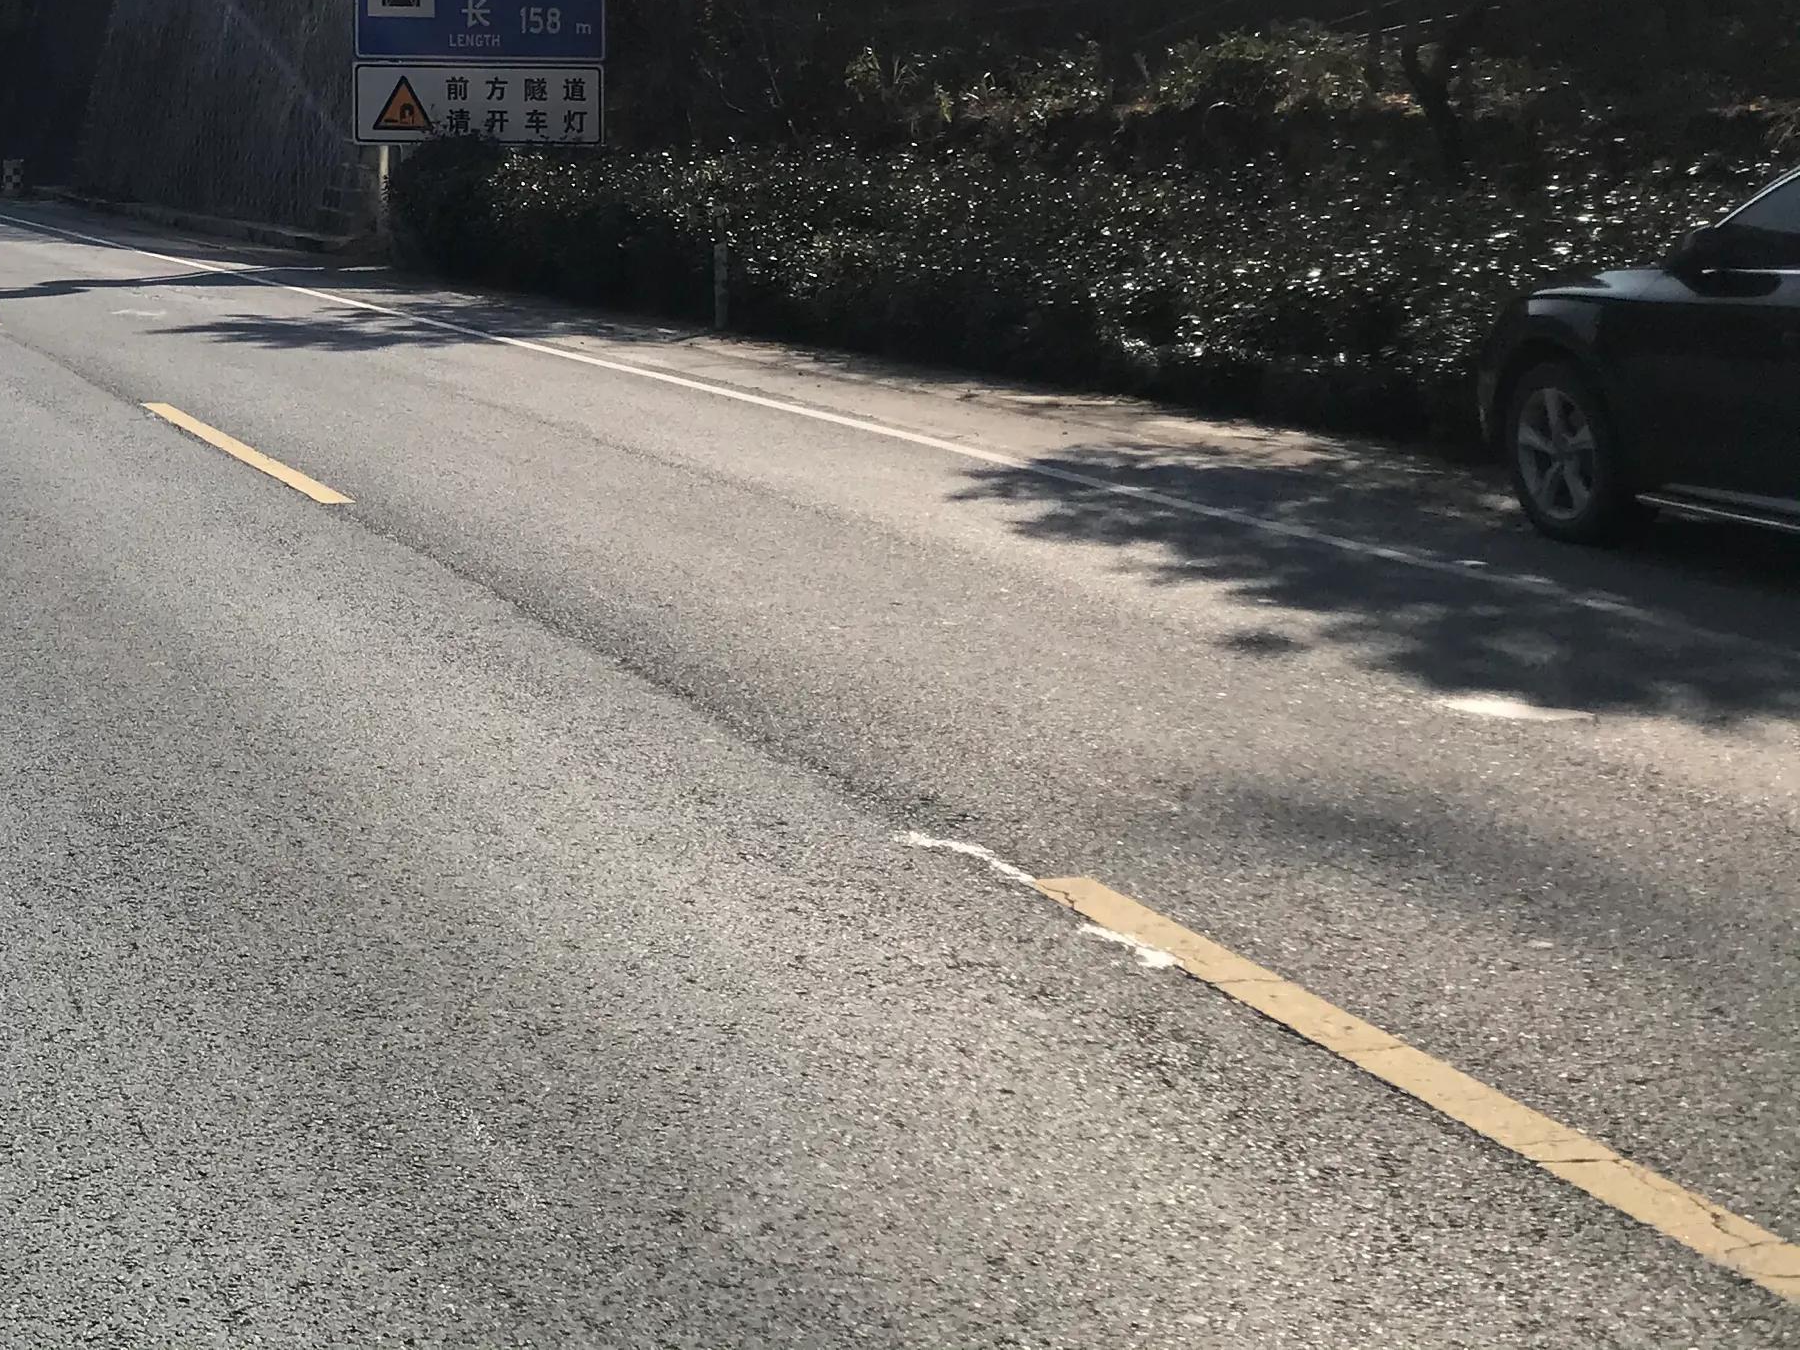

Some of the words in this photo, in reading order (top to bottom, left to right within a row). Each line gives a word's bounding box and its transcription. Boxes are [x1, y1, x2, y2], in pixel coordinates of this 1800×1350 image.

[519, 6, 562, 35] 158
[575, 22, 592, 35] m
[449, 34, 501, 48] LENGTH
[445, 76, 587, 102] 前方隧道
[446, 108, 588, 135] 请开车灯
